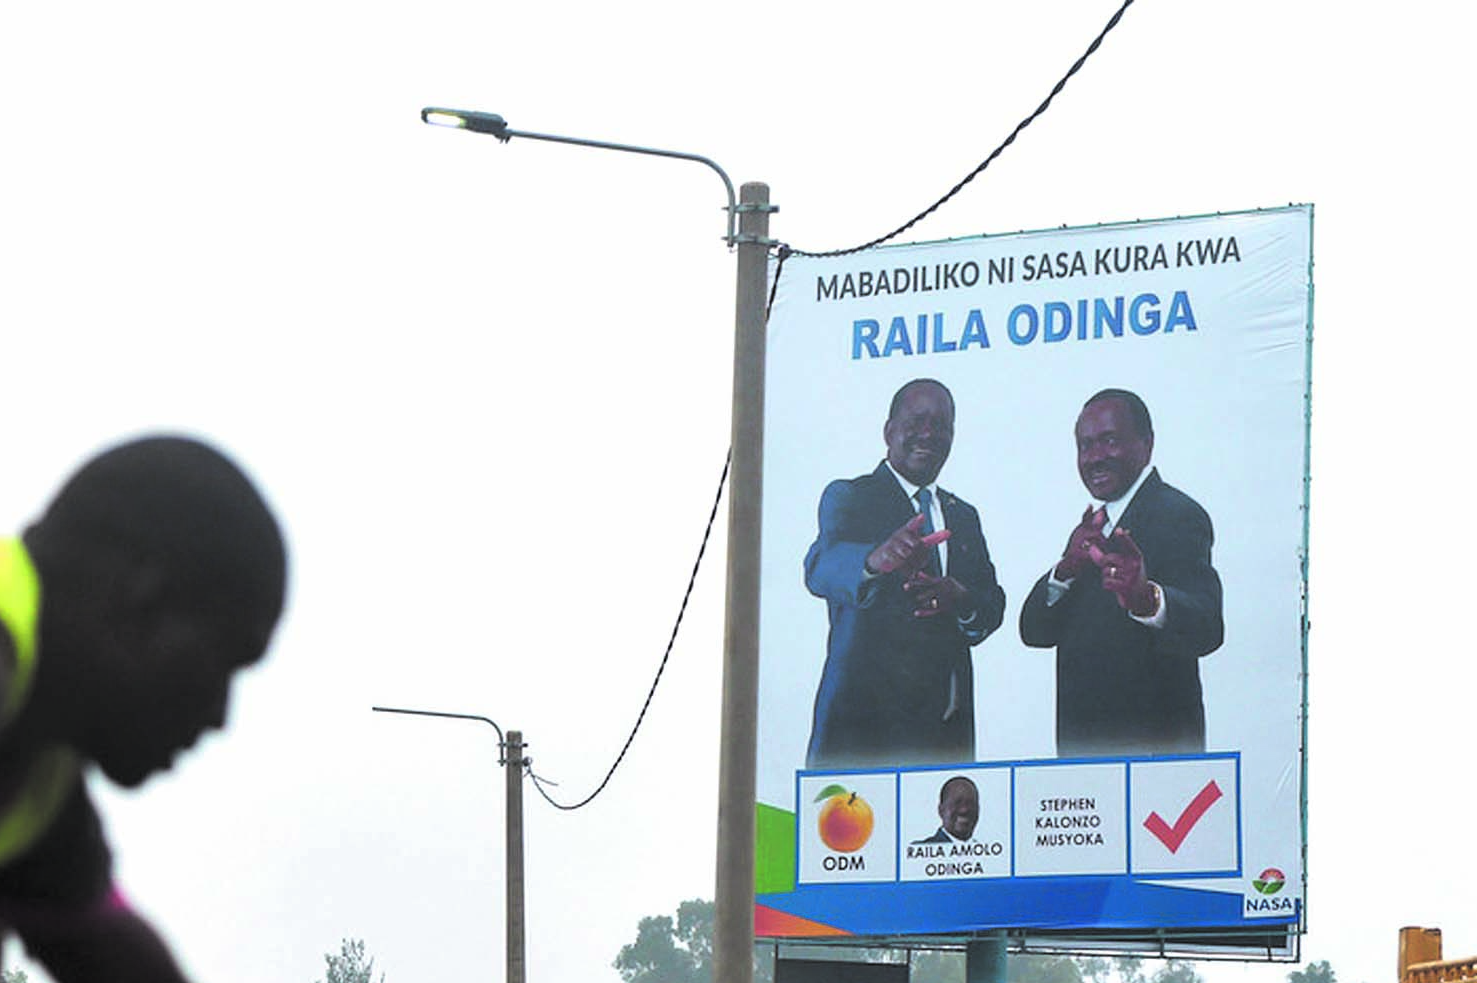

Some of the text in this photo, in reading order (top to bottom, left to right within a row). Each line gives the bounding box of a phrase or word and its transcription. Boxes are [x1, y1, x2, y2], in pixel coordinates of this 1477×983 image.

[816, 236, 1242, 301] MABADILIKO NI SASA KURA KWA
[851, 290, 1197, 360] RAILA ODINGA
[1040, 798, 1096, 812] STEPHEN
[1035, 815, 1101, 829] KALONZO
[1035, 833, 1104, 847] MUSYOKA
[907, 842, 1003, 859] RAILA AMOLO
[823, 856, 866, 872] ODM
[925, 862, 984, 876] ODINGA
[1246, 897, 1292, 912] NASA
